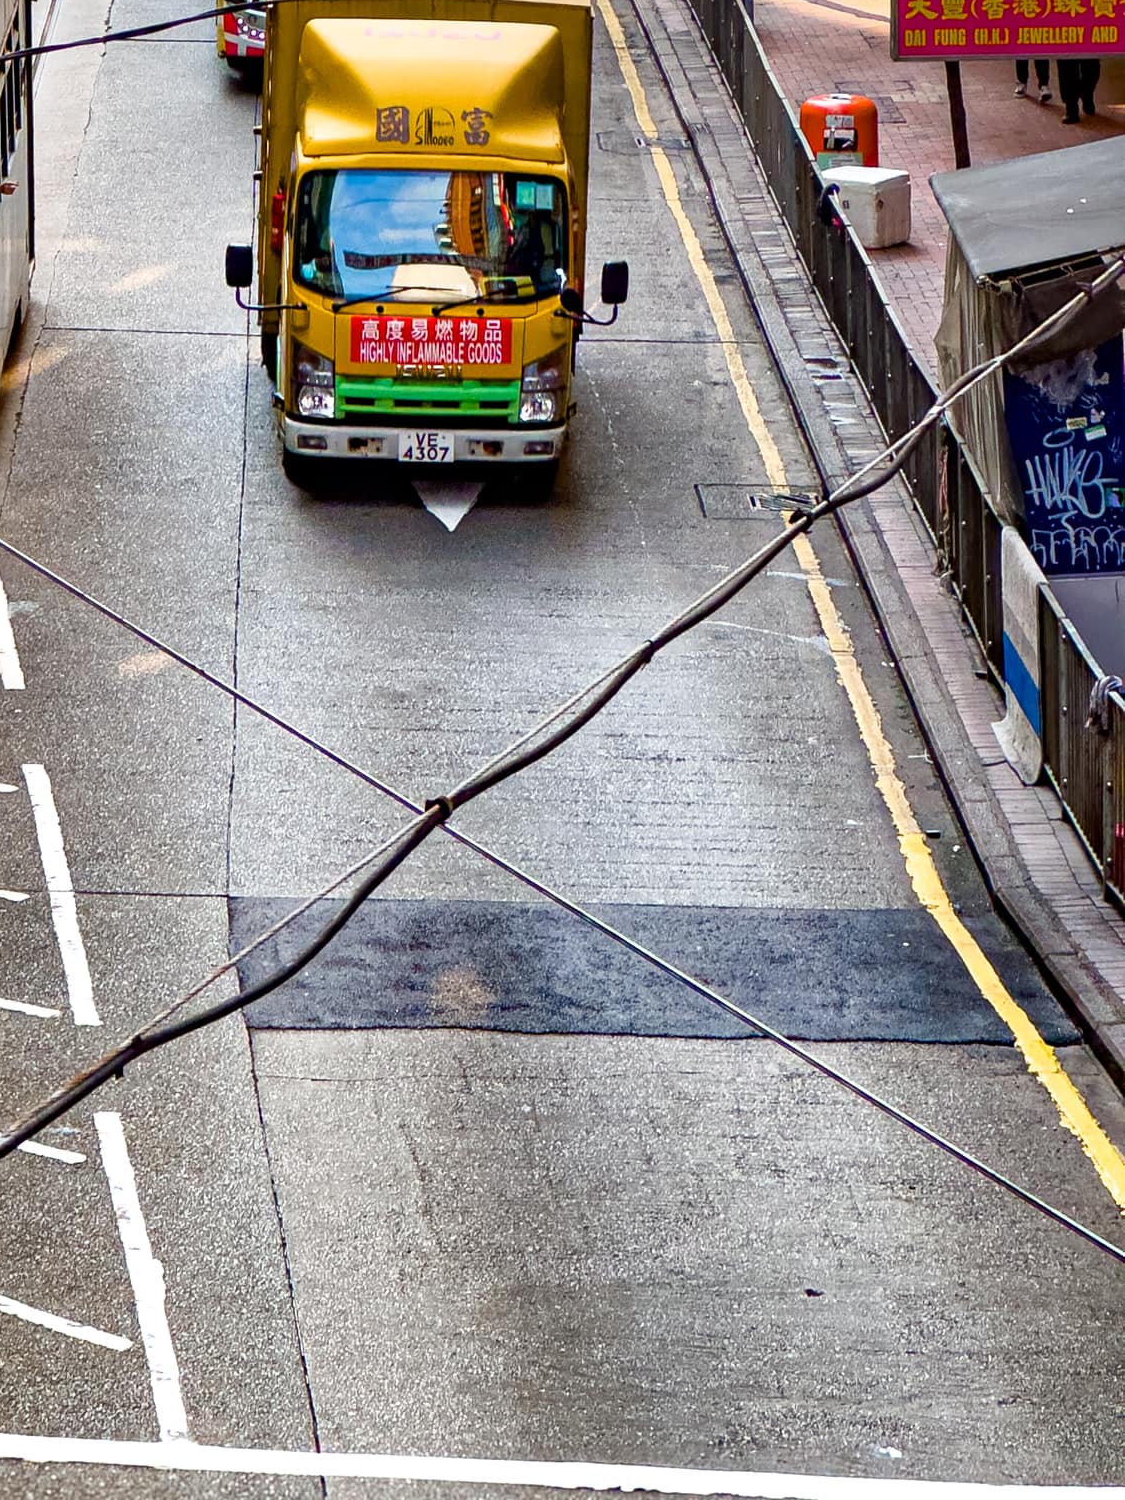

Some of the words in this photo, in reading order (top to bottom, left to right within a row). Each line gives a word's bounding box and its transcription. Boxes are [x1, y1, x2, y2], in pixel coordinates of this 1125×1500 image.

[905, 29, 926, 47] DAI
[934, 28, 967, 46] FUNG
[1016, 26, 1085, 45] JEWELLERY
[1091, 26, 1118, 45] AND
[362, 318, 502, 341] 高度易燃物品
[360, 342, 395, 363] HIGHLY
[396, 342, 464, 363] INFLAMMABLE
[467, 343, 502, 364] GOODS
[416, 433, 439, 447] VE
[403, 447, 450, 461] 4307
